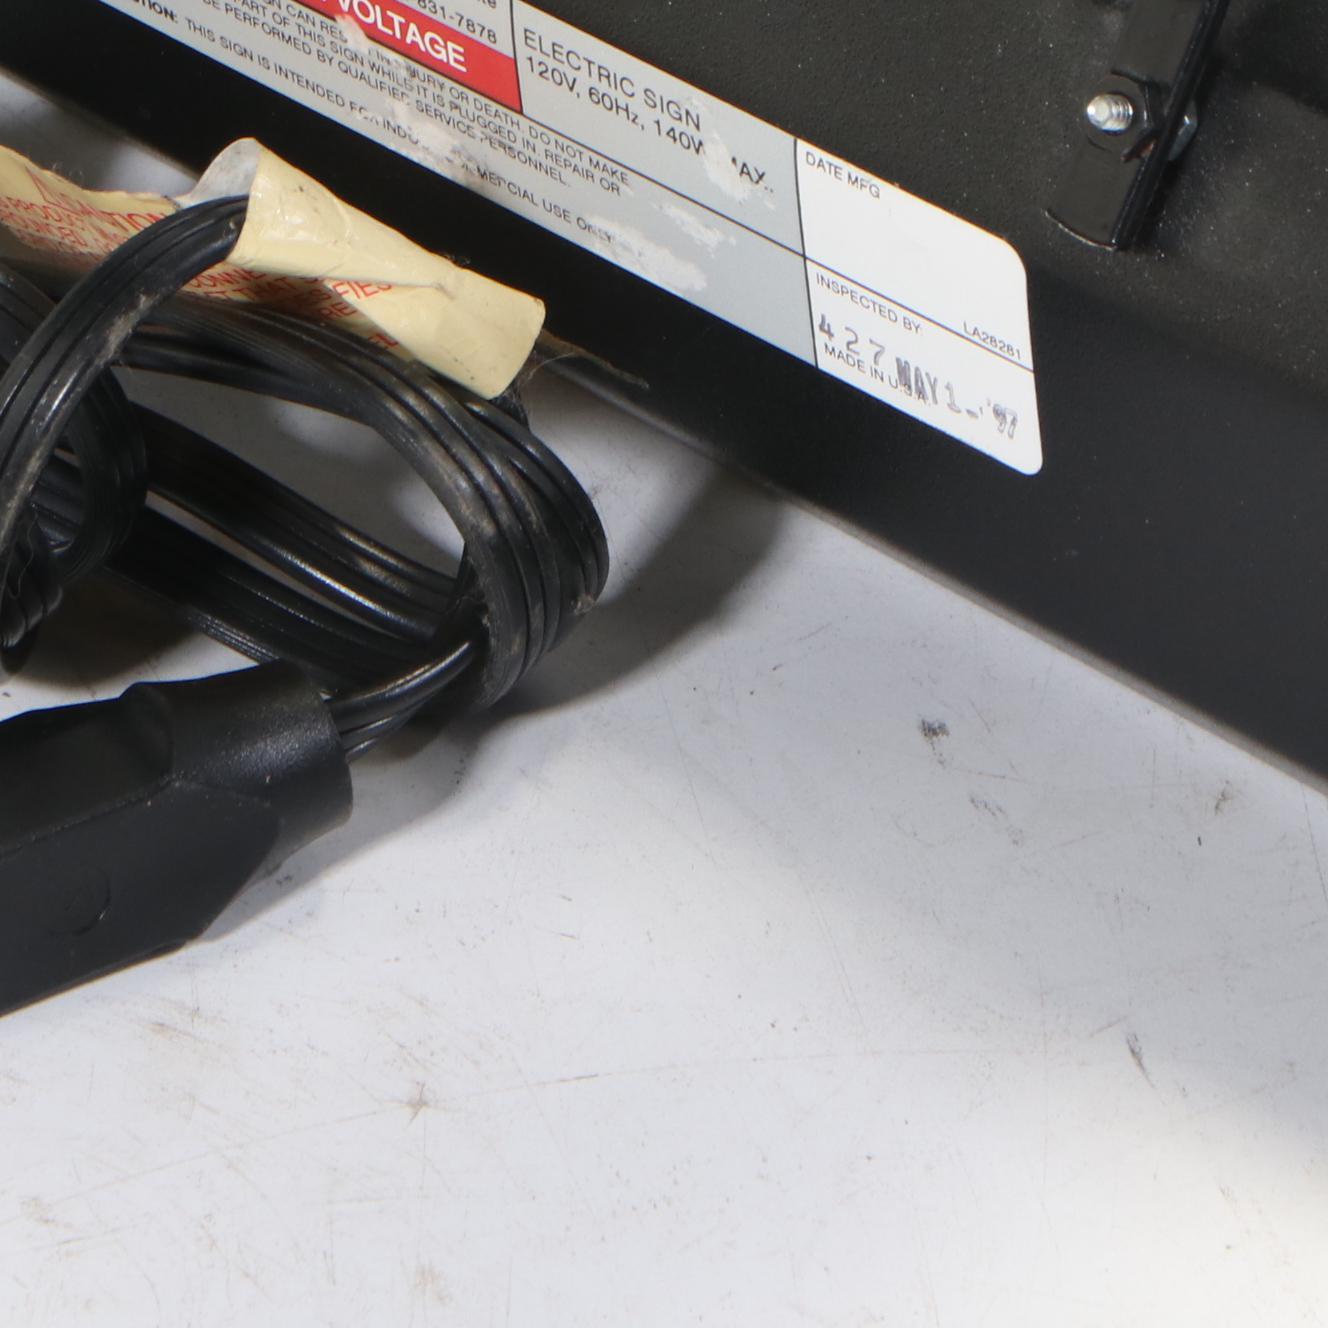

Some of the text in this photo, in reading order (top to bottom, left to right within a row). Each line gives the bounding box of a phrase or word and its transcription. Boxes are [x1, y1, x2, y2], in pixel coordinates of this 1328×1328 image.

[225, 3, 311, 55] PERFORMED
[317, 49, 333, 67] BY
[416, 100, 475, 138] SERVICE
[272, 11, 289, 29] OF
[295, 23, 325, 47] THIS
[330, 41, 364, 66] SIGN
[449, 101, 516, 143] PLUGGED
[545, 149, 594, 183] REPAIR
[600, 176, 620, 196] OR
[286, 3, 315, 27] CAN
[449, 85, 469, 104] OR
[529, 125, 550, 145] DO
[555, 139, 583, 162] NOT
[589, 156, 628, 185] MAKE
[524, 28, 700, 131] ELECTRIC SIGN
[527, 56, 579, 98] 120V,
[589, 87, 644, 130] 60Hz,
[185, 17, 215, 42] THIS
[220, 35, 253, 62] SIGN
[257, 53, 270, 70] IS
[275, 64, 345, 107] INTENDED
[543, 199, 570, 223] USE
[806, 152, 879, 199] DATE MFG
[817, 273, 897, 322] INSPECTED
[824, 343, 864, 372] MADE
[895, 357, 937, 404] MAY
